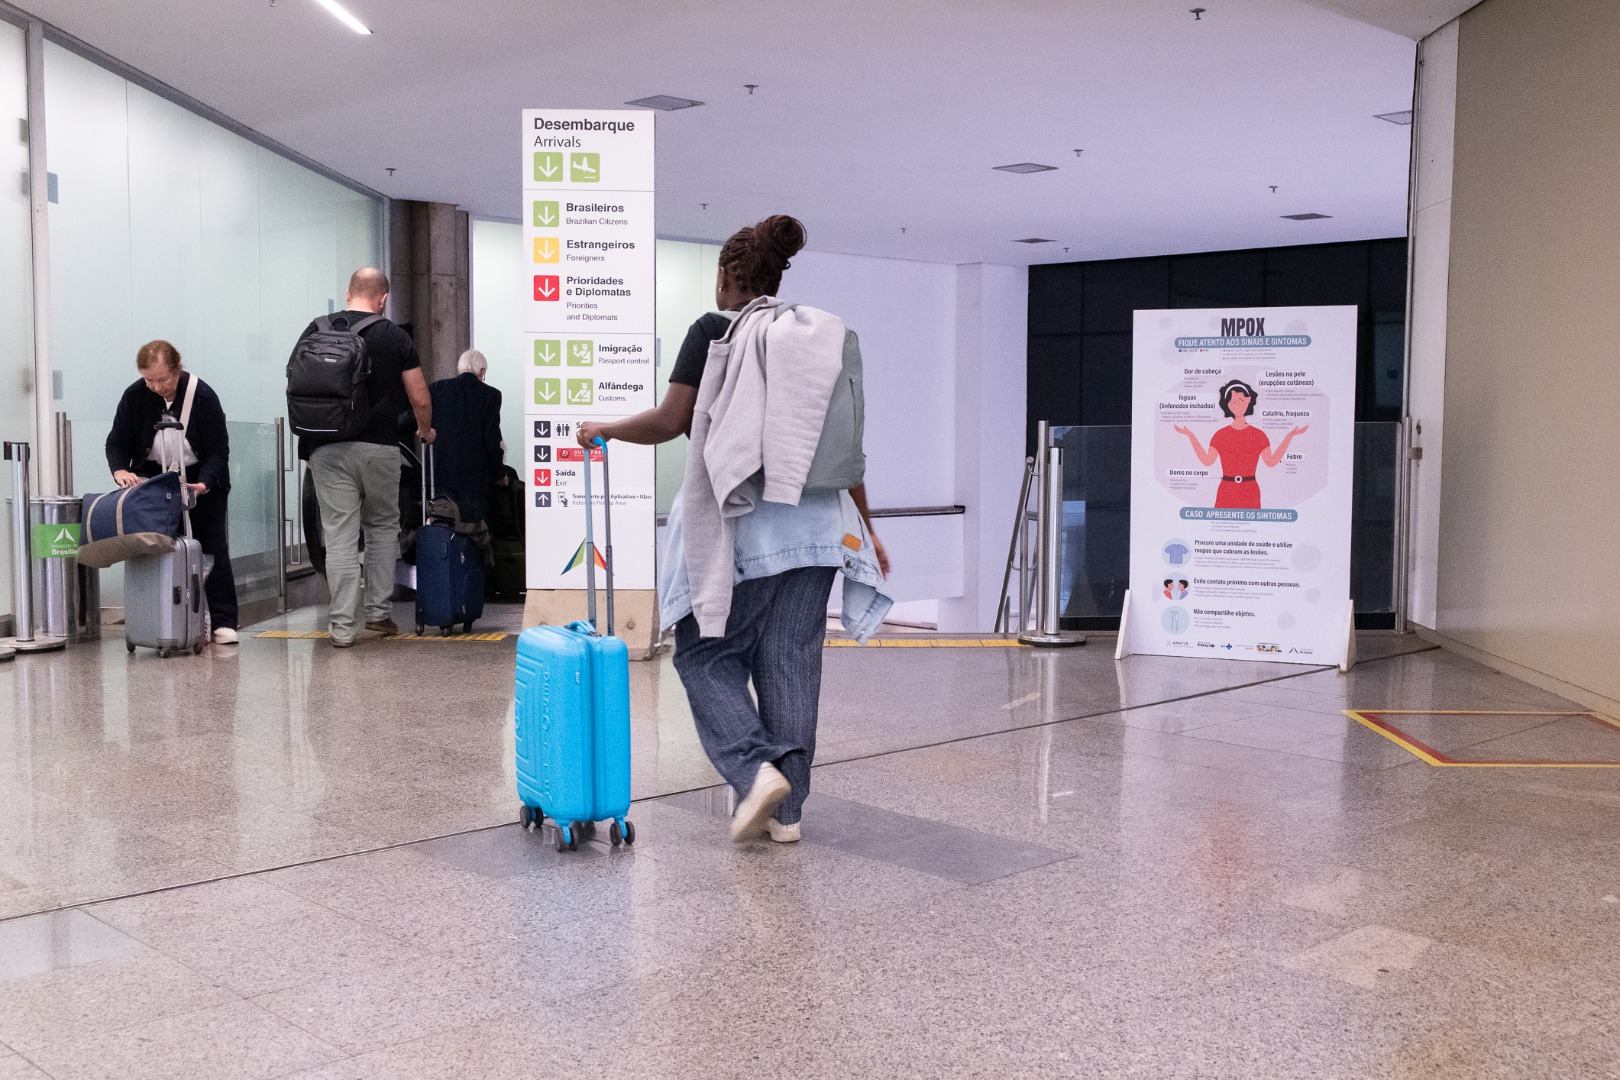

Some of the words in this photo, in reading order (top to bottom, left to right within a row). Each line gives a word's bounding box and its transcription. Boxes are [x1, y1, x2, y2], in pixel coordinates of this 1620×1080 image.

[534, 118, 634, 134] Desembarque
[534, 136, 581, 148] Arrivals
[566, 203, 624, 212] Brasileiros
[566, 240, 635, 251] Estrangeiros
[566, 254, 605, 262] Foreigners
[566, 276, 624, 285] Prioridades
[576, 288, 631, 297] Diplomatas
[1221, 317, 1266, 336] MPOX
[1178, 339, 1198, 347] FIQUE
[1271, 337, 1307, 345] SINTOMAS
[599, 344, 642, 354] Imigração
[598, 382, 643, 392] Alfândega
